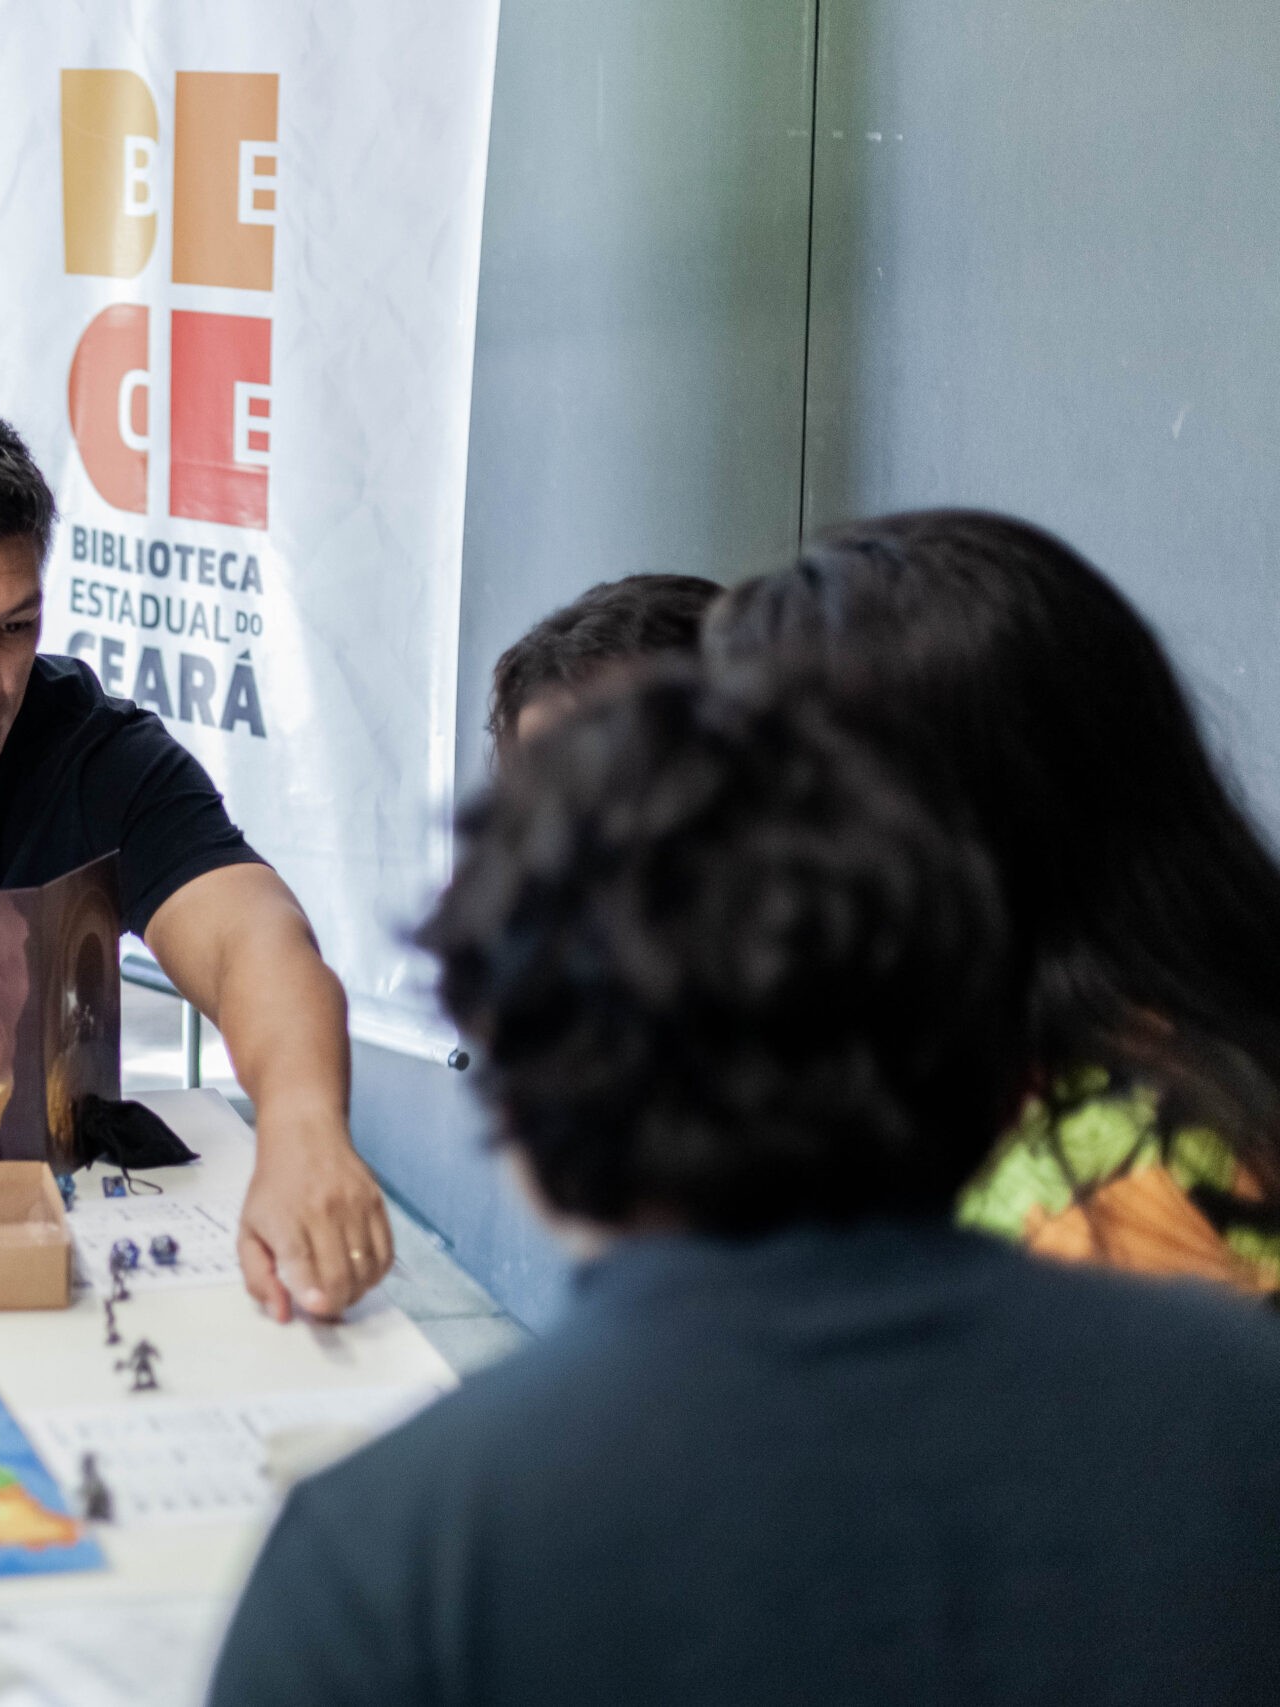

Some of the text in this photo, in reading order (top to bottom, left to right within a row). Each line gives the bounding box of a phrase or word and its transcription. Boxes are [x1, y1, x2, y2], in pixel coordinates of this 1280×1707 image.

[71, 525, 264, 595] BIBLIOTECA
[70, 577, 264, 645] ESTADUAL DO
